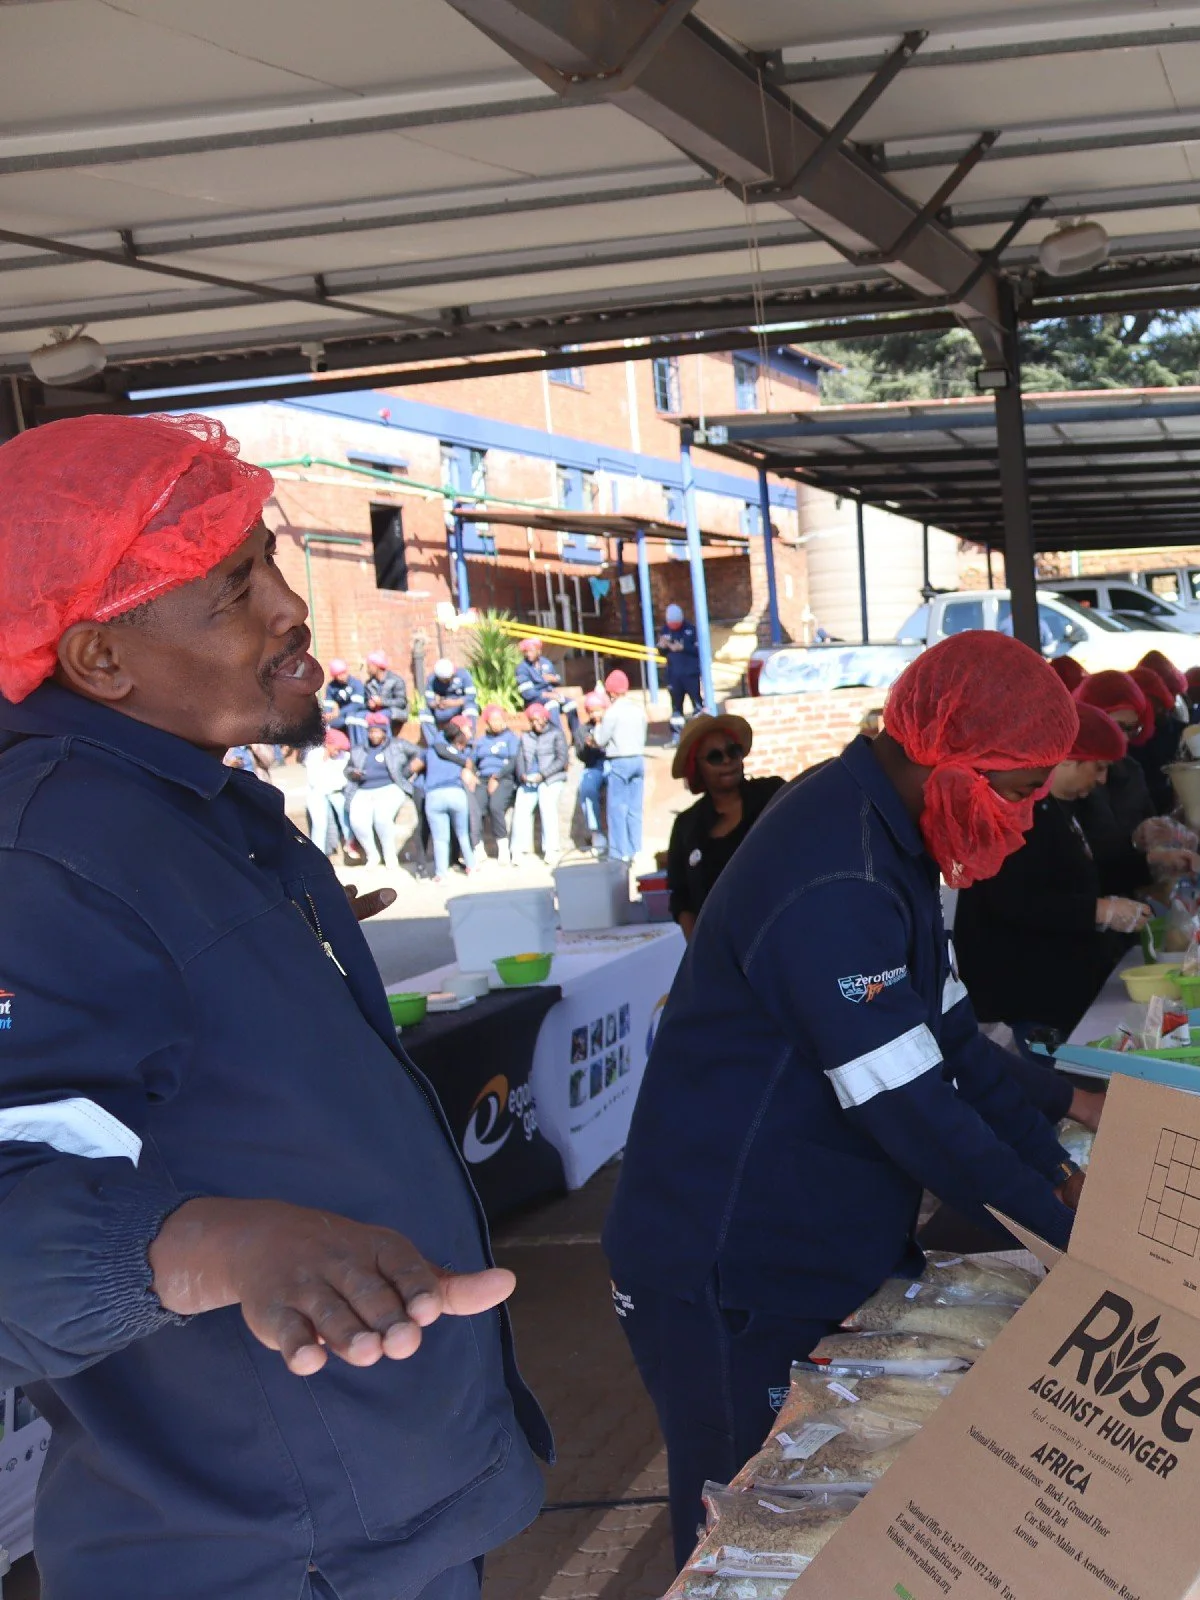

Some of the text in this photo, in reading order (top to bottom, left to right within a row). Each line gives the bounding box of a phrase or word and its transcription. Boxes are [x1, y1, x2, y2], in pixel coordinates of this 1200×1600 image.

[1028, 1374, 1178, 1480] AGAINST HUNGER
[1031, 1408, 1133, 1484] food community sustainability
[966, 1425, 991, 1447] National
[987, 1440, 1005, 1457] Head
[1001, 1451, 1020, 1469] Office
[1044, 1483, 1065, 1503] Block
[1067, 1500, 1094, 1524] Ground
[1091, 1517, 1111, 1537] Floor
[1030, 1442, 1092, 1495] AFRICA
[905, 1500, 930, 1524] National
[925, 1517, 943, 1537] Office
[951, 1541, 965, 1556] +27
[974, 1561, 988, 1577] 872
[983, 1571, 1002, 1589] 2498
[1013, 1524, 1039, 1549] Aeroton
[1034, 1497, 1069, 1528] Omni Park
[886, 1525, 952, 1595] Website: www.rahafrica.org
[913, 1529, 962, 1580] info@rahafrica.org
[1024, 1511, 1038, 1526] Cnr
[1036, 1520, 1056, 1540] Sailor
[1054, 1534, 1075, 1557] Malan
[1074, 1551, 1084, 1562] &
[1081, 1557, 1119, 1591] Aerodrome
